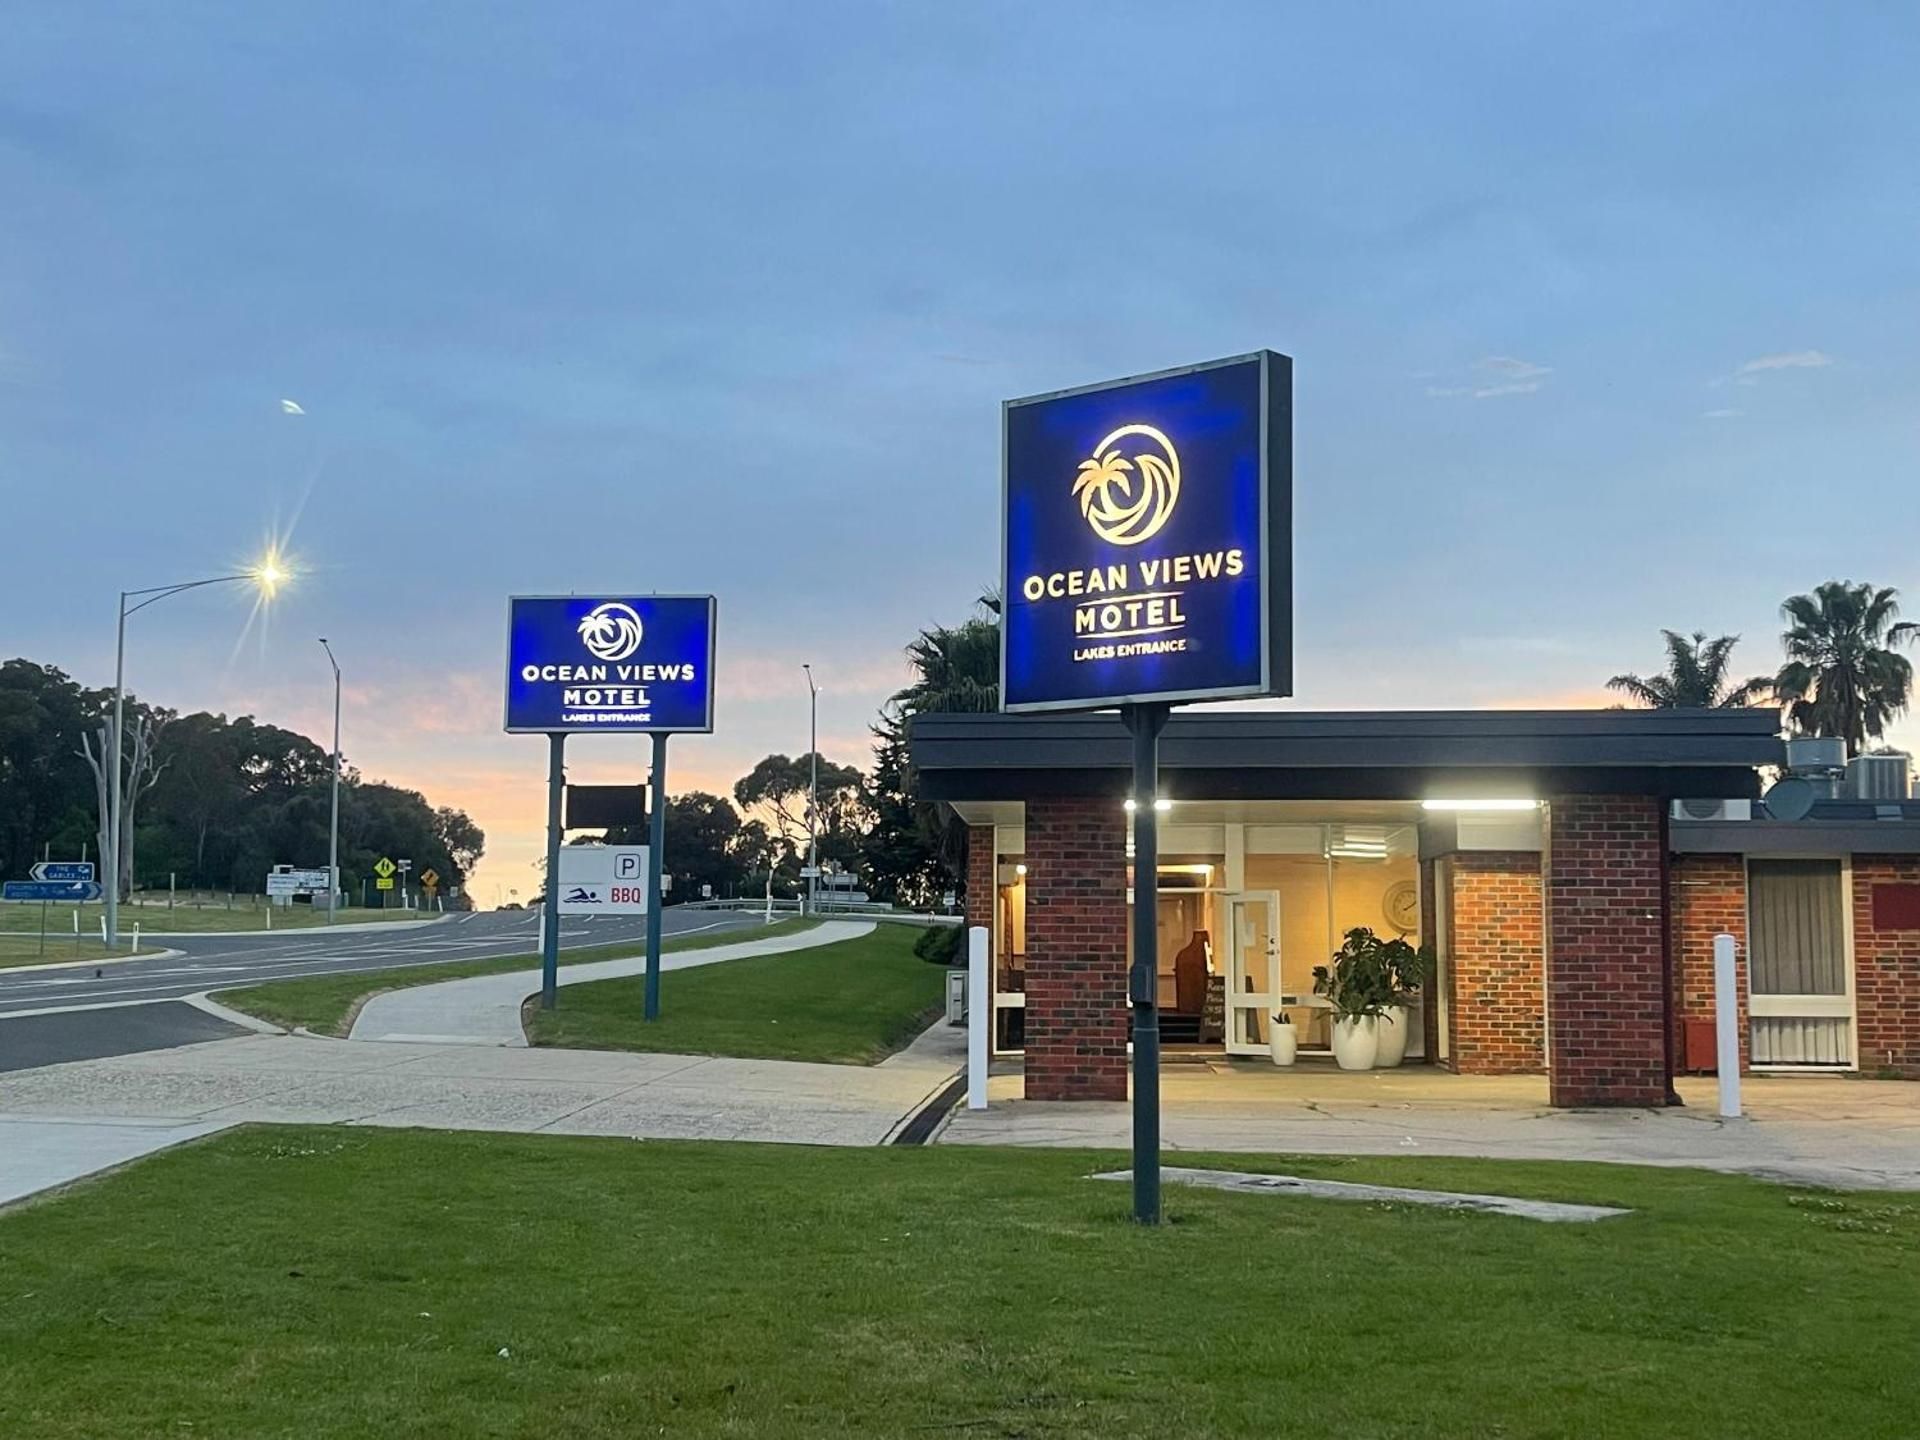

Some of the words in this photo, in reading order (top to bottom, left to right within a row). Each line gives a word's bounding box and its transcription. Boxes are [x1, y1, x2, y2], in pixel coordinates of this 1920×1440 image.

[1023, 563, 1128, 601] OCEAN
[1139, 549, 1244, 587] VIEWS
[1075, 598, 1186, 633] MOTEL
[1073, 643, 1116, 661] LAKES
[1117, 639, 1187, 657] ENTRANCE
[522, 664, 606, 682] OCEAN
[617, 664, 695, 681] VIEWS
[563, 689, 651, 705] MOTEL
[562, 713, 596, 722] LAKES
[597, 713, 651, 722] ENTRANCE
[622, 858, 635, 876] P
[611, 887, 641, 904] BBQ
